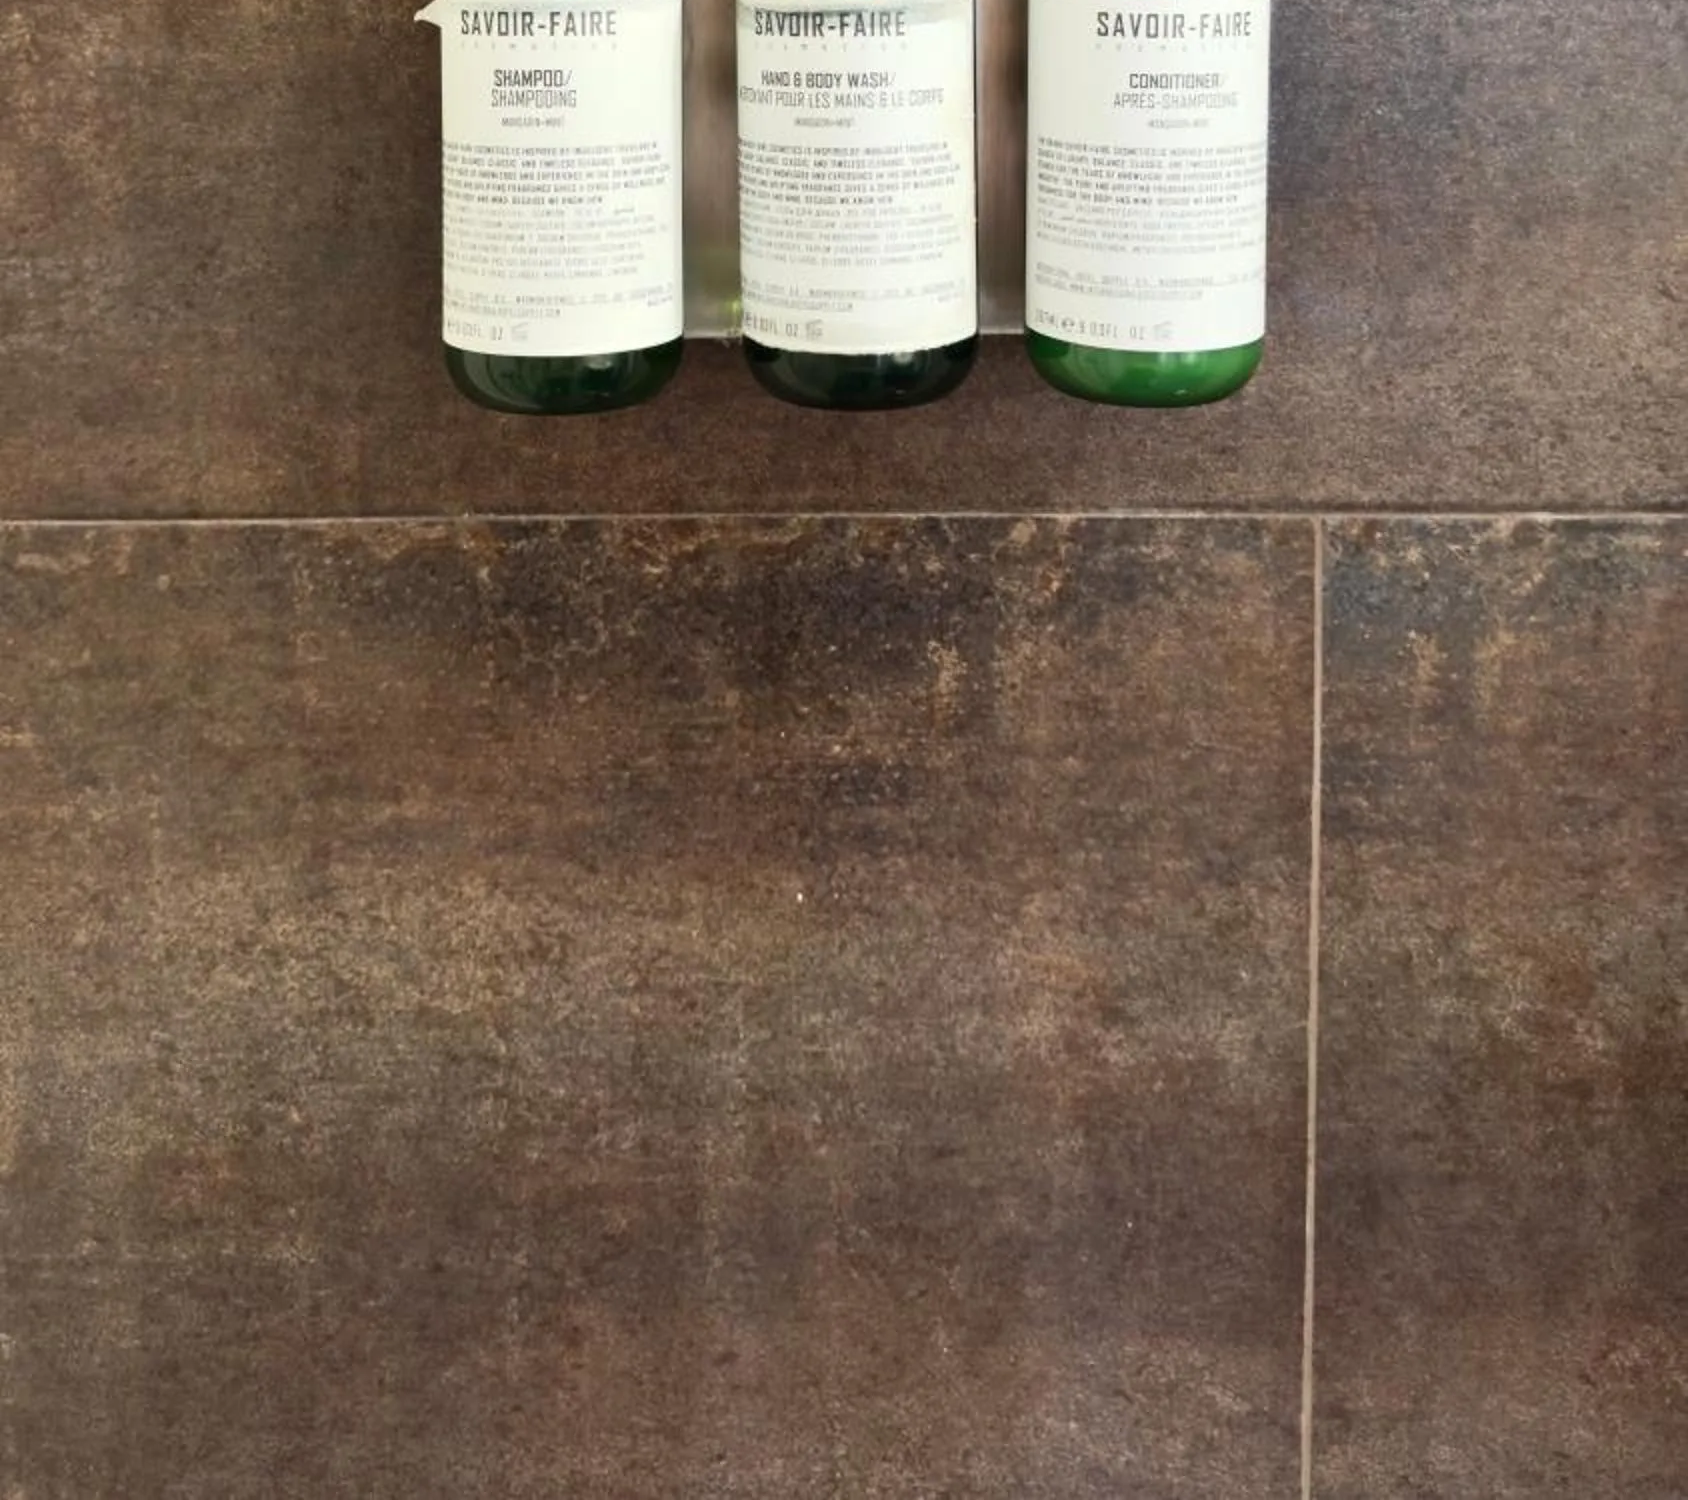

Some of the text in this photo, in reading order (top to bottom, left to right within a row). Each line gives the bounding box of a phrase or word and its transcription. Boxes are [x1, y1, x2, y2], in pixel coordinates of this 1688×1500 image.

[460, 9, 618, 37] SAVOIR-FAIRE
[754, 10, 907, 37] SAVOIR-FAIRE
[1096, 11, 1252, 38] SAVOIR-FAIRE
[761, 70, 791, 87] HAND
[793, 71, 801, 88] &
[806, 72, 842, 89] BODY
[491, 89, 577, 108] SHAMPOOING
[775, 91, 805, 106] POUR
[808, 91, 831, 109] LES
[834, 91, 875, 109] MAINS
[891, 90, 905, 108] LE
